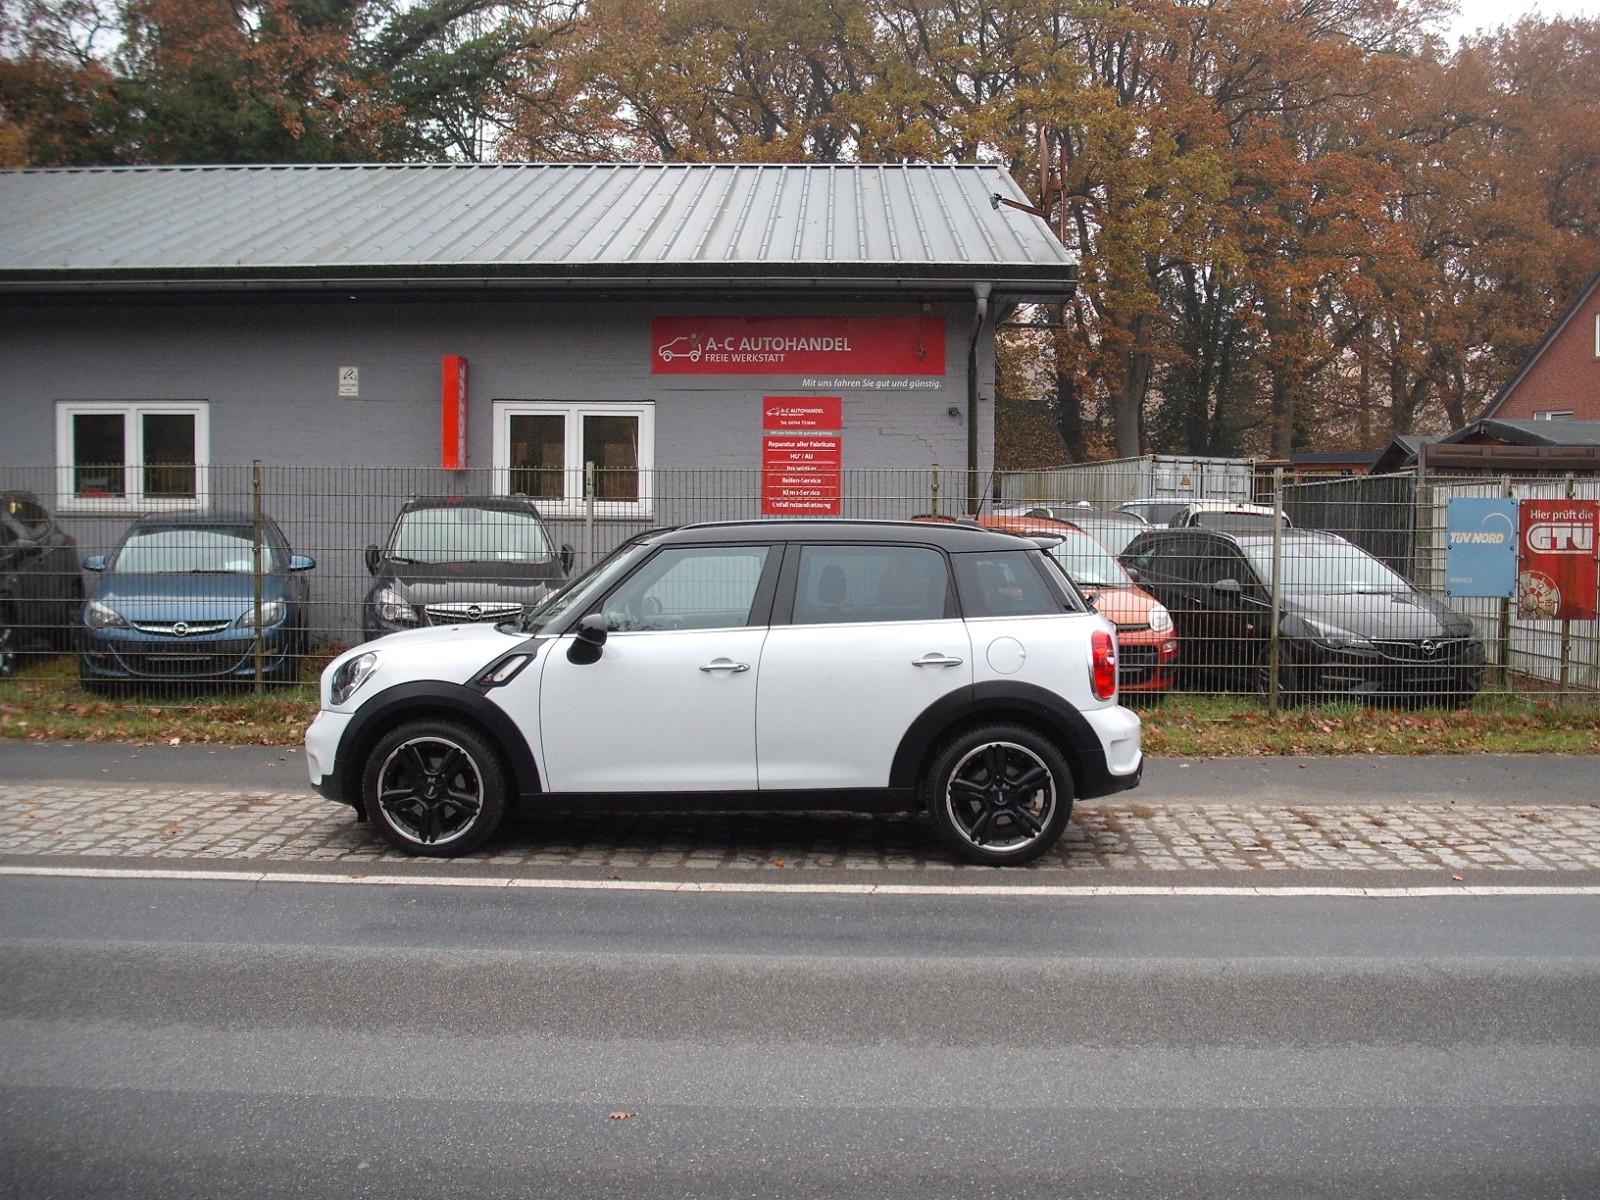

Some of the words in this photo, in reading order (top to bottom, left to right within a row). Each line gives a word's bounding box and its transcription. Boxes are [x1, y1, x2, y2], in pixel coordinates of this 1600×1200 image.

[705, 337, 735, 351] A-C
[739, 337, 851, 352] AUTOHANDEL
[705, 353, 729, 363] FREIE
[731, 353, 785, 363] WERKSTATT
[802, 378, 816, 388] Mit
[817, 380, 832, 388] uns
[833, 378, 861, 388] fahren
[862, 379, 873, 388] Sie
[875, 379, 890, 390] gut
[891, 379, 908, 388] und
[909, 379, 942, 390] günstig.
[1530, 510, 1550, 520] Hier
[1552, 509, 1577, 521] prüft
[1578, 510, 1594, 520] die
[1471, 532, 1504, 544] NORD
